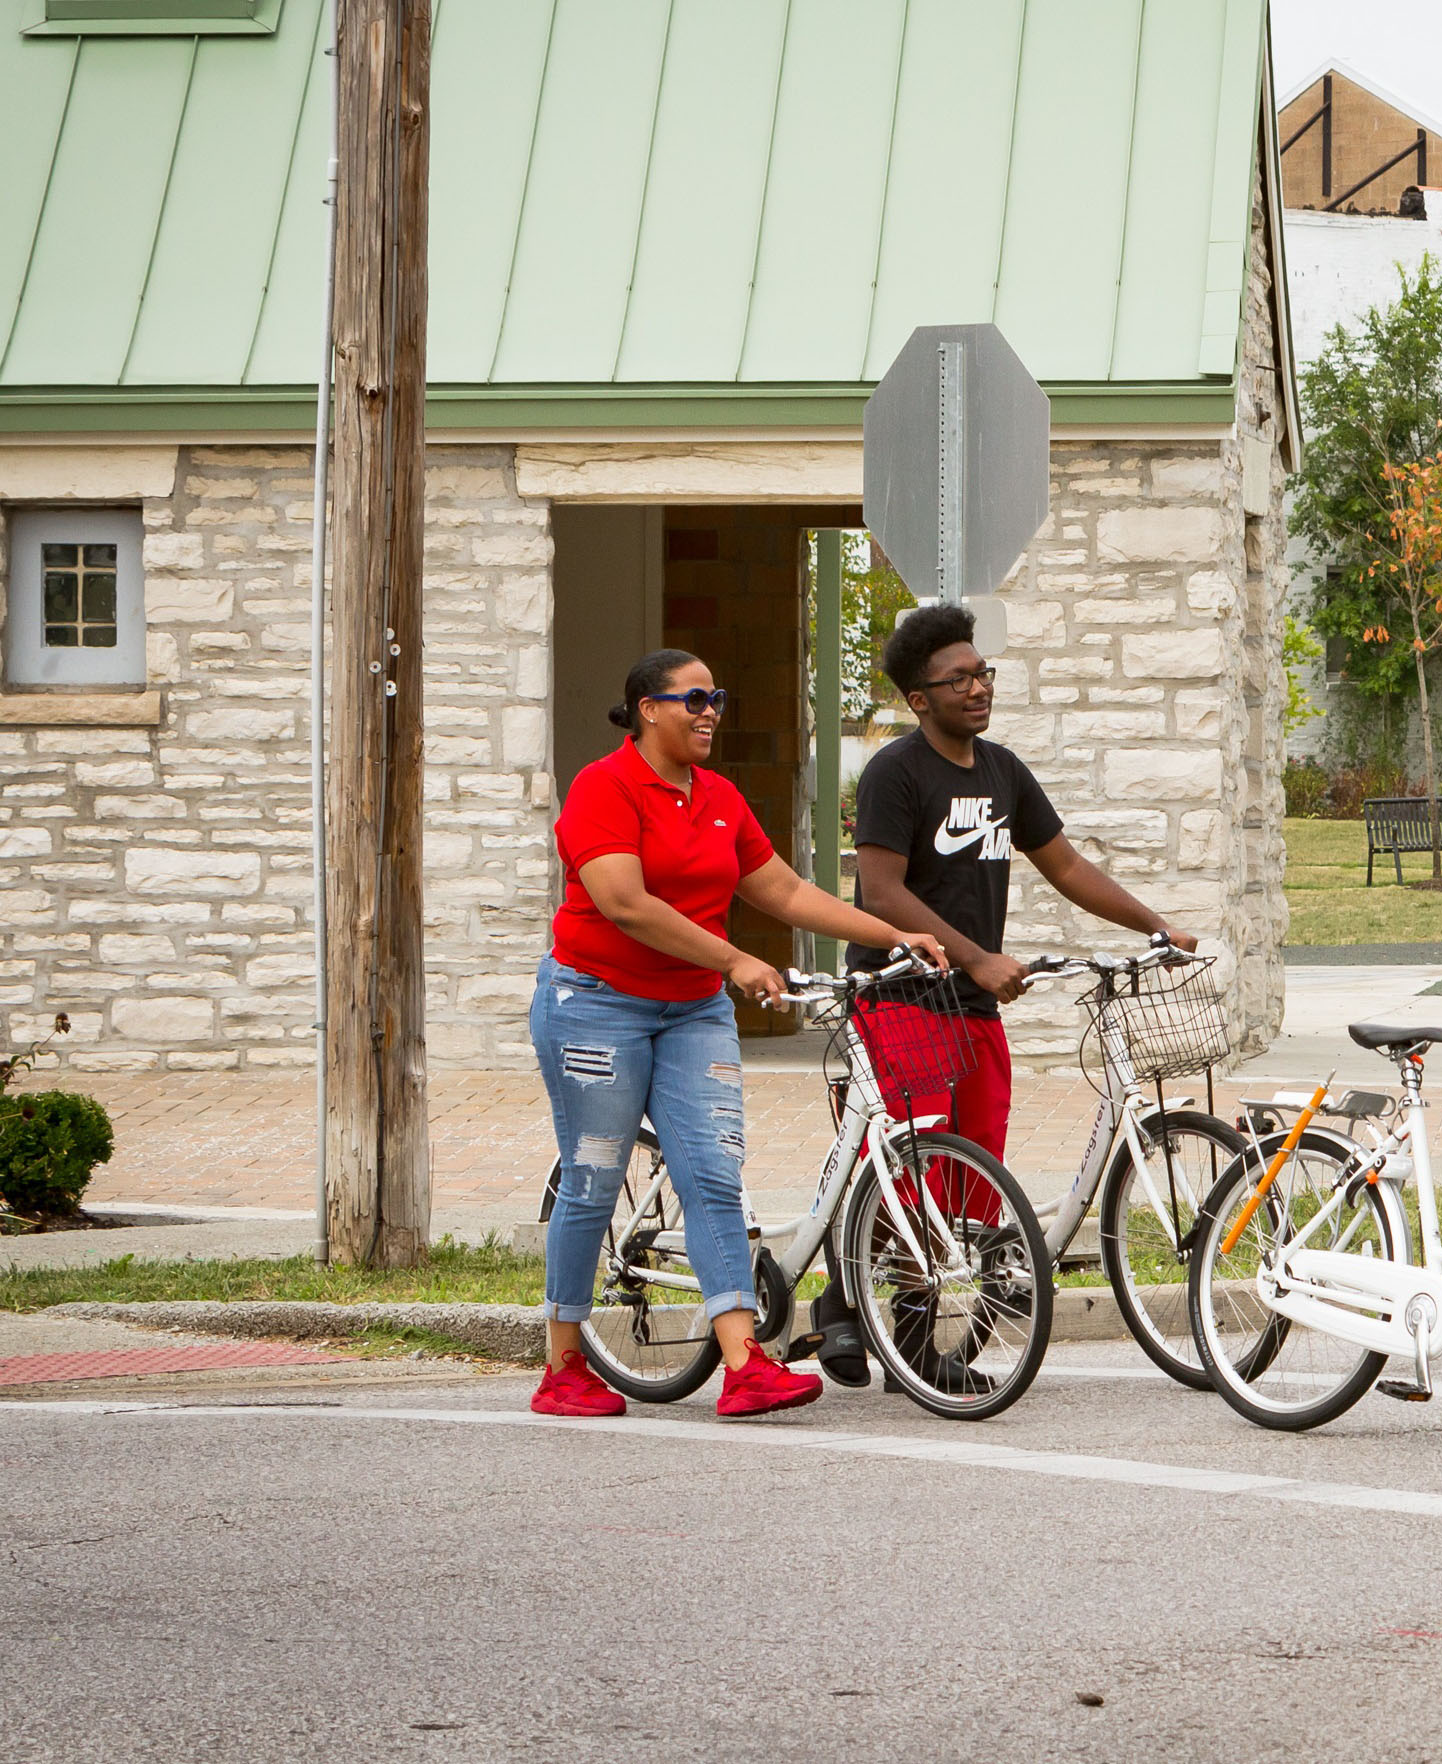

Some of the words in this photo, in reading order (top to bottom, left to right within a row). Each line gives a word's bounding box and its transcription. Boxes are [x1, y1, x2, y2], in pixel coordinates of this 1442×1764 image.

[947, 797, 993, 829] NIKE
[978, 827, 1011, 860] AIR
[817, 1119, 849, 1197] Zagster
